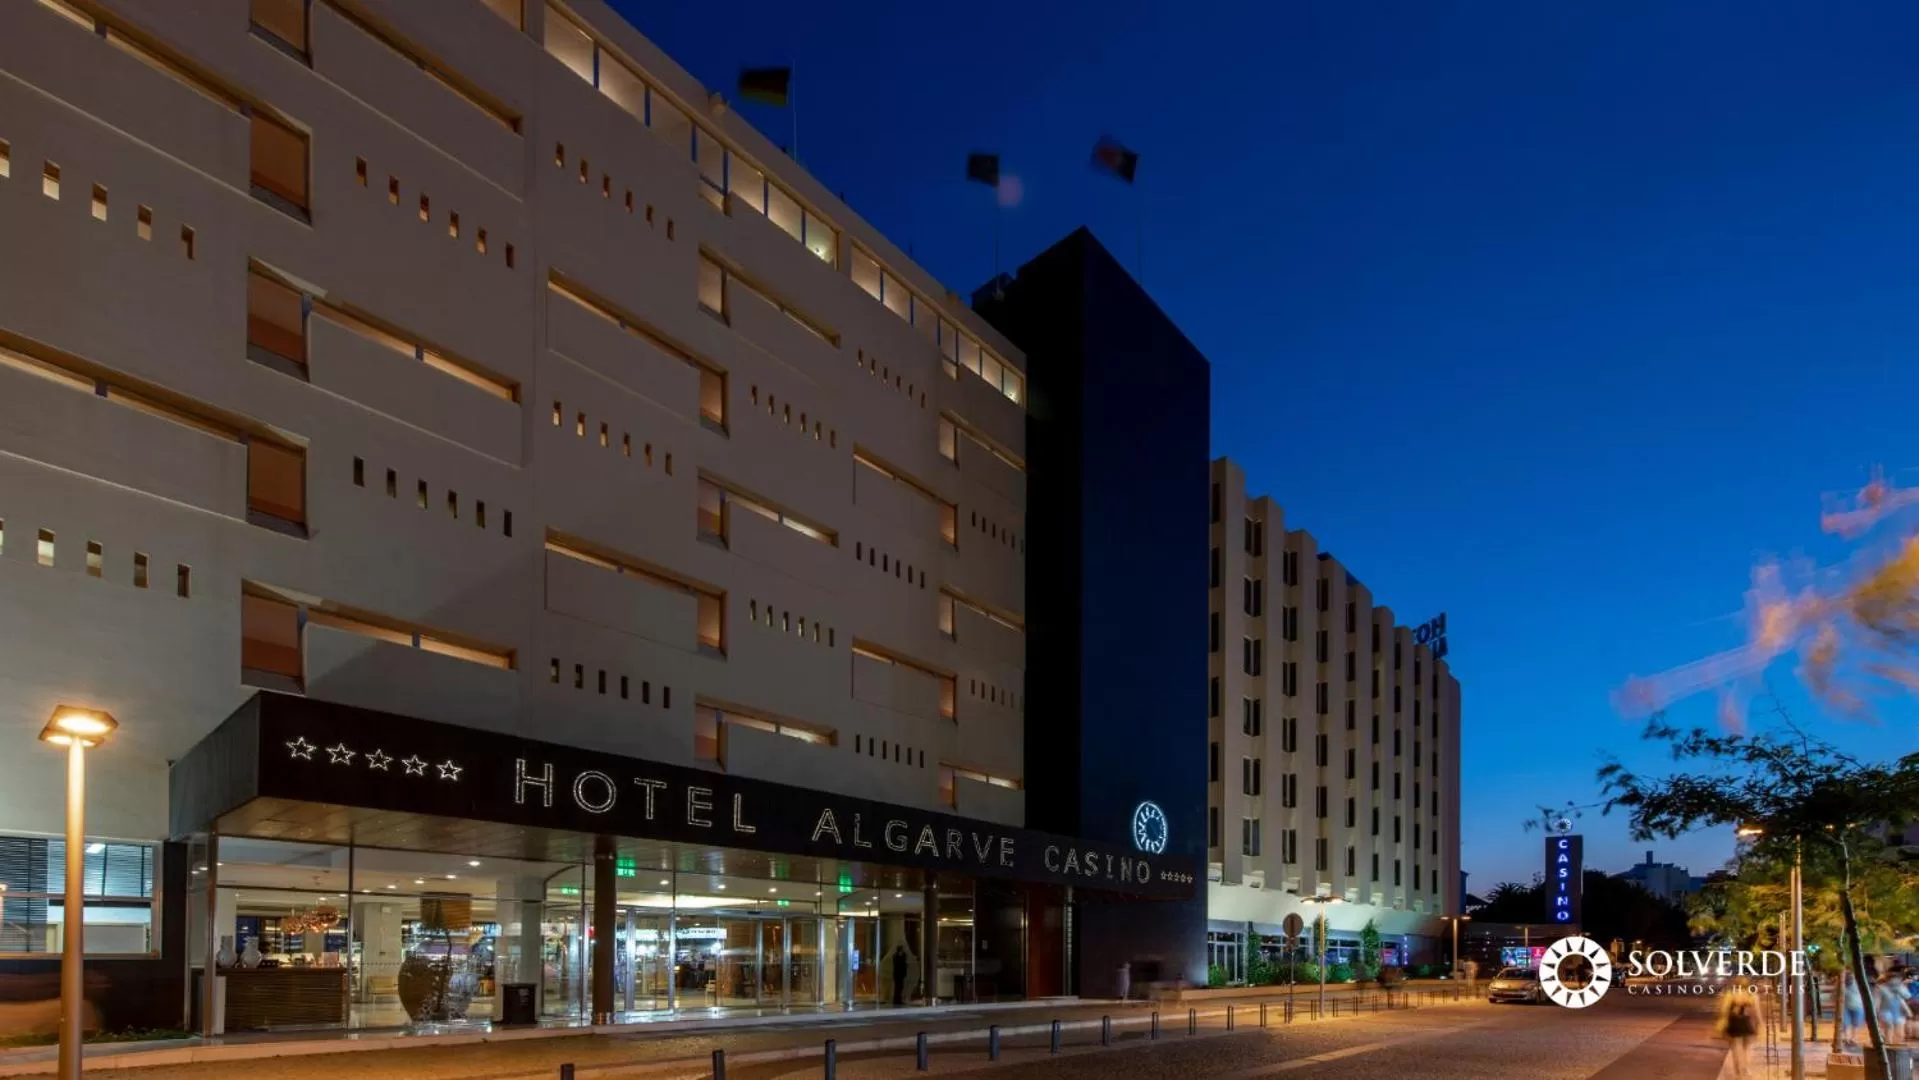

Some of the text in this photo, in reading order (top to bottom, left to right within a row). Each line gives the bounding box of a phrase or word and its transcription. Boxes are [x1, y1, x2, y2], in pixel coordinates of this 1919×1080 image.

[514, 758, 1152, 885] HOTEL ALGARVE CASINO
[1557, 839, 1569, 920] CASINO
